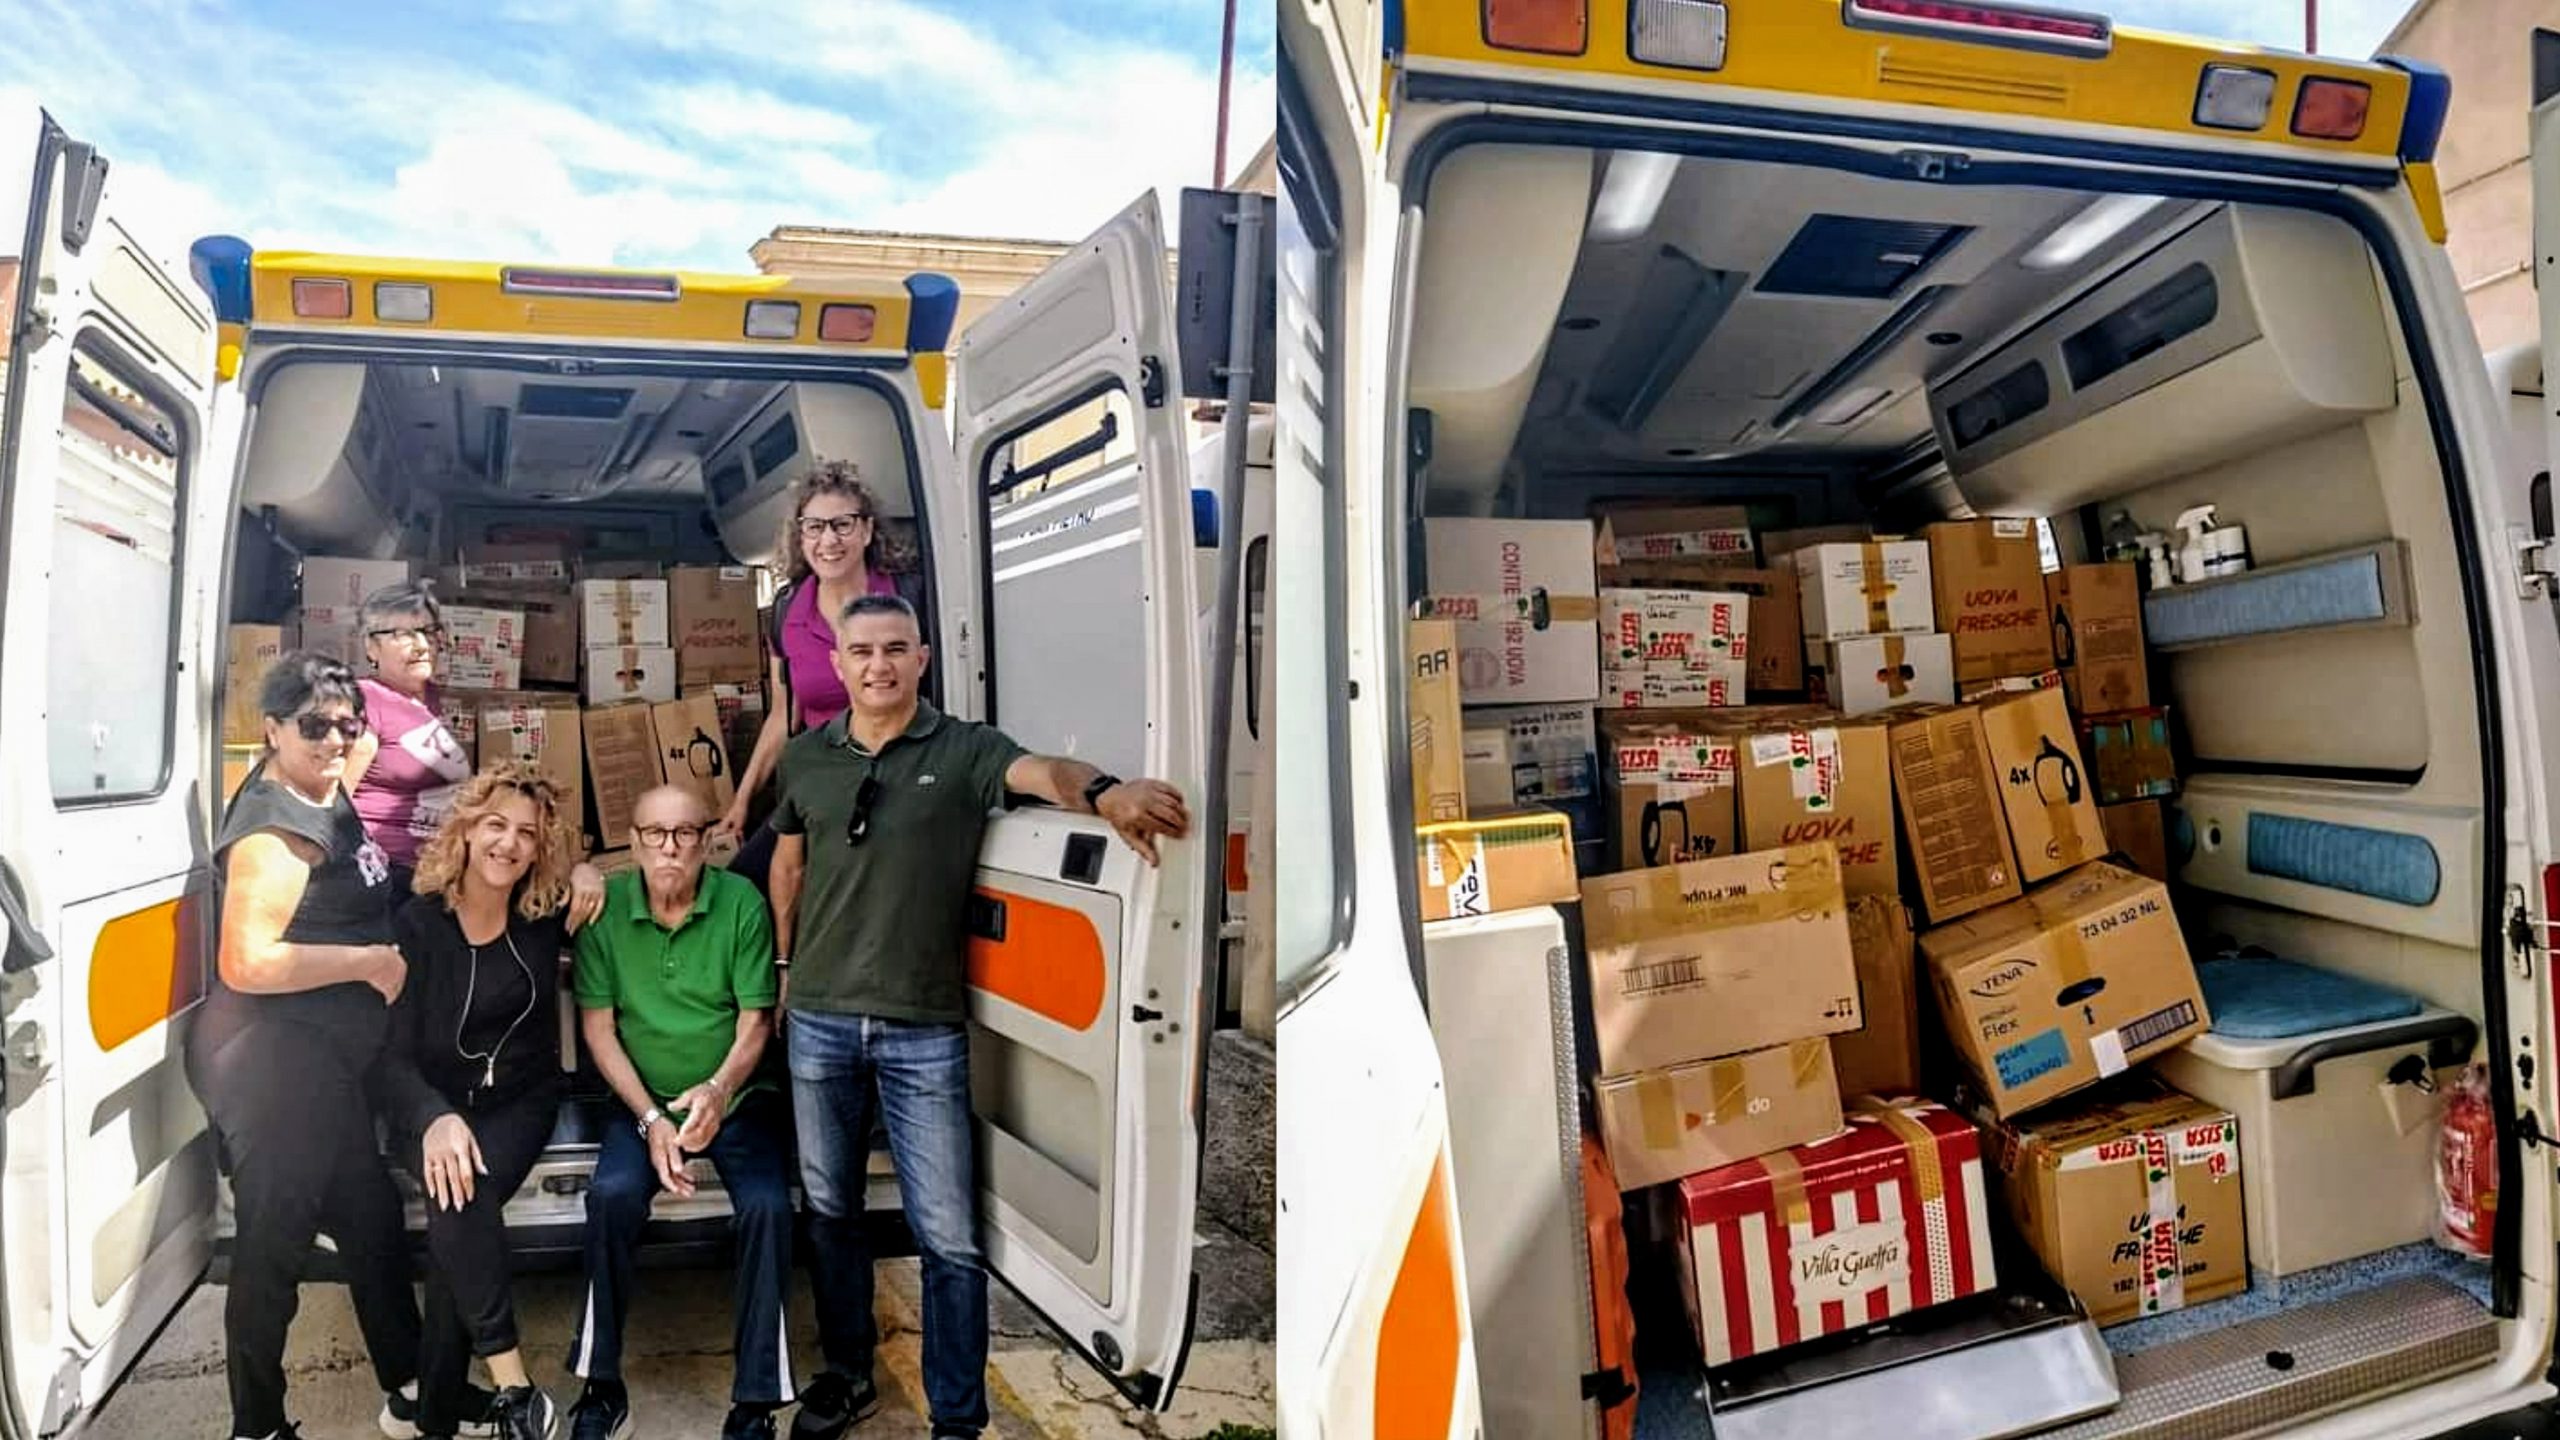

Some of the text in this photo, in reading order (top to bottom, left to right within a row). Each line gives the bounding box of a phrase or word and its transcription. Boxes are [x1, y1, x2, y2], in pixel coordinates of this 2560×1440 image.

[1502, 541, 1521, 595] CONTIE
[1965, 590, 2018, 608] UOVA
[1956, 608, 2044, 634] FRESCHE
[1506, 647, 1526, 686] UOVA
[1619, 748, 1659, 768] SISA
[2009, 767, 2032, 786] 4x
[1781, 816, 1856, 845] UOVA
[2081, 900, 2160, 939] 73 04 32 NL
[1982, 966, 2023, 990] TENA
[1983, 1018, 2020, 1041] Flex
[2187, 1124, 2223, 1148] SISA
[2098, 1141, 2138, 1161] SISA
[2154, 1221, 2174, 1266] SISA
[1802, 1240, 1900, 1286] Villa Guelfa
